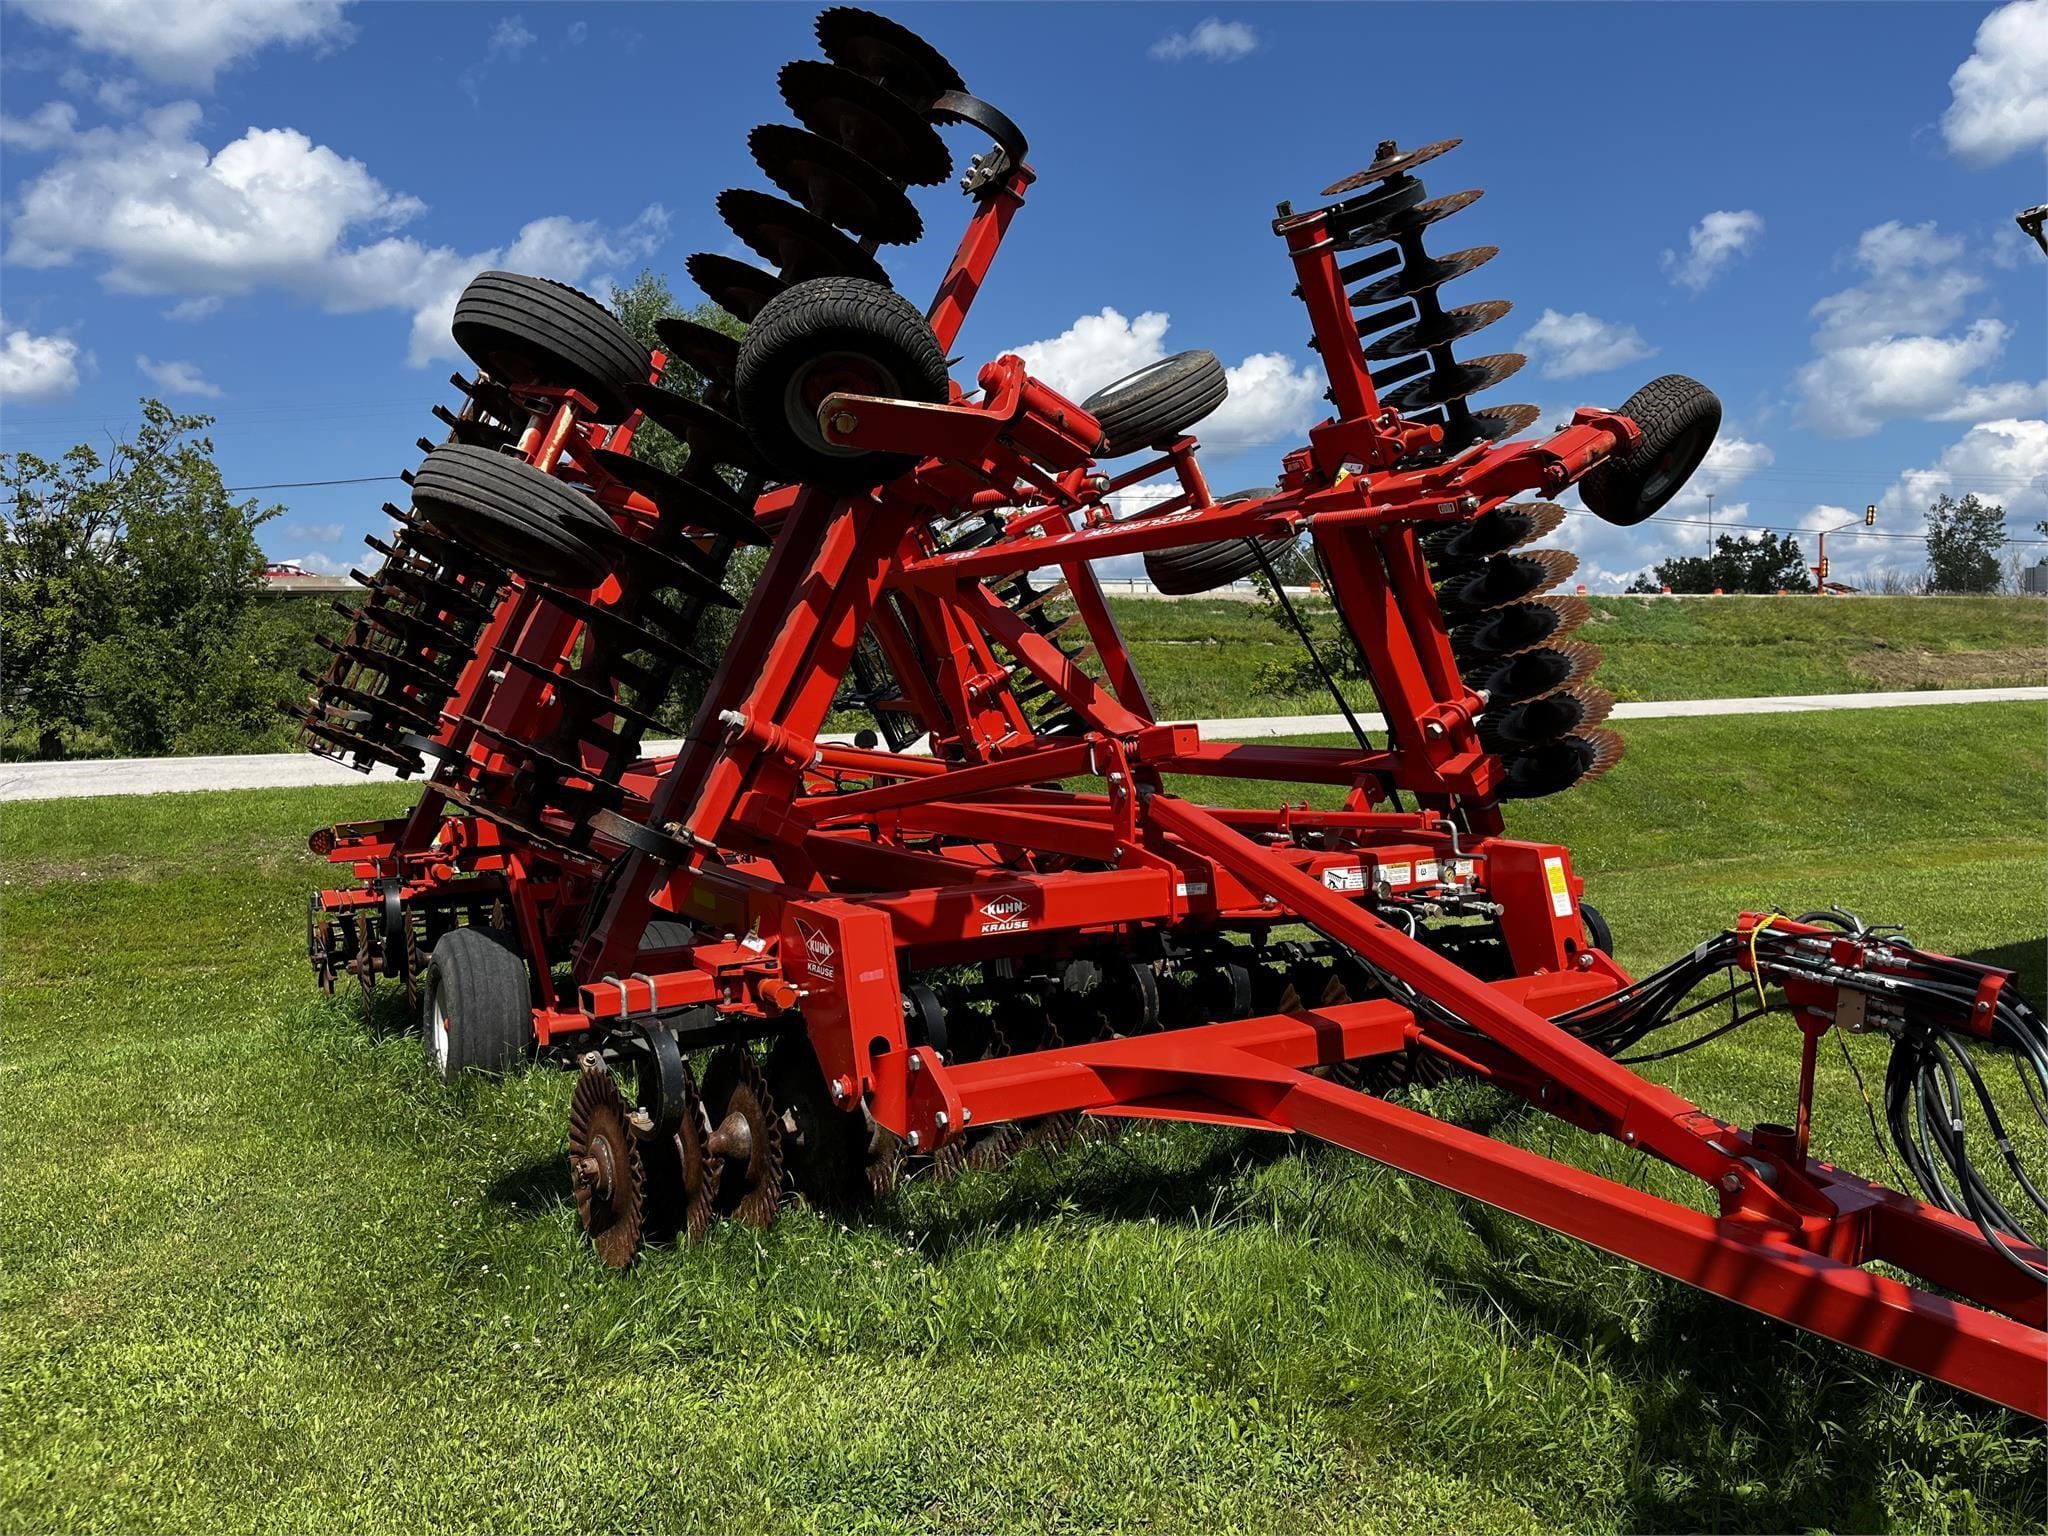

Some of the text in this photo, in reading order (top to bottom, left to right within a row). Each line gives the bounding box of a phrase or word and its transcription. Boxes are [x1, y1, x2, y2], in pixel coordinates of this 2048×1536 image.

[987, 902, 1023, 915] KUHN
[981, 920, 1029, 933] KRAUSE
[809, 940, 830, 956] KUHN
[807, 963, 834, 978] KRAUSE
